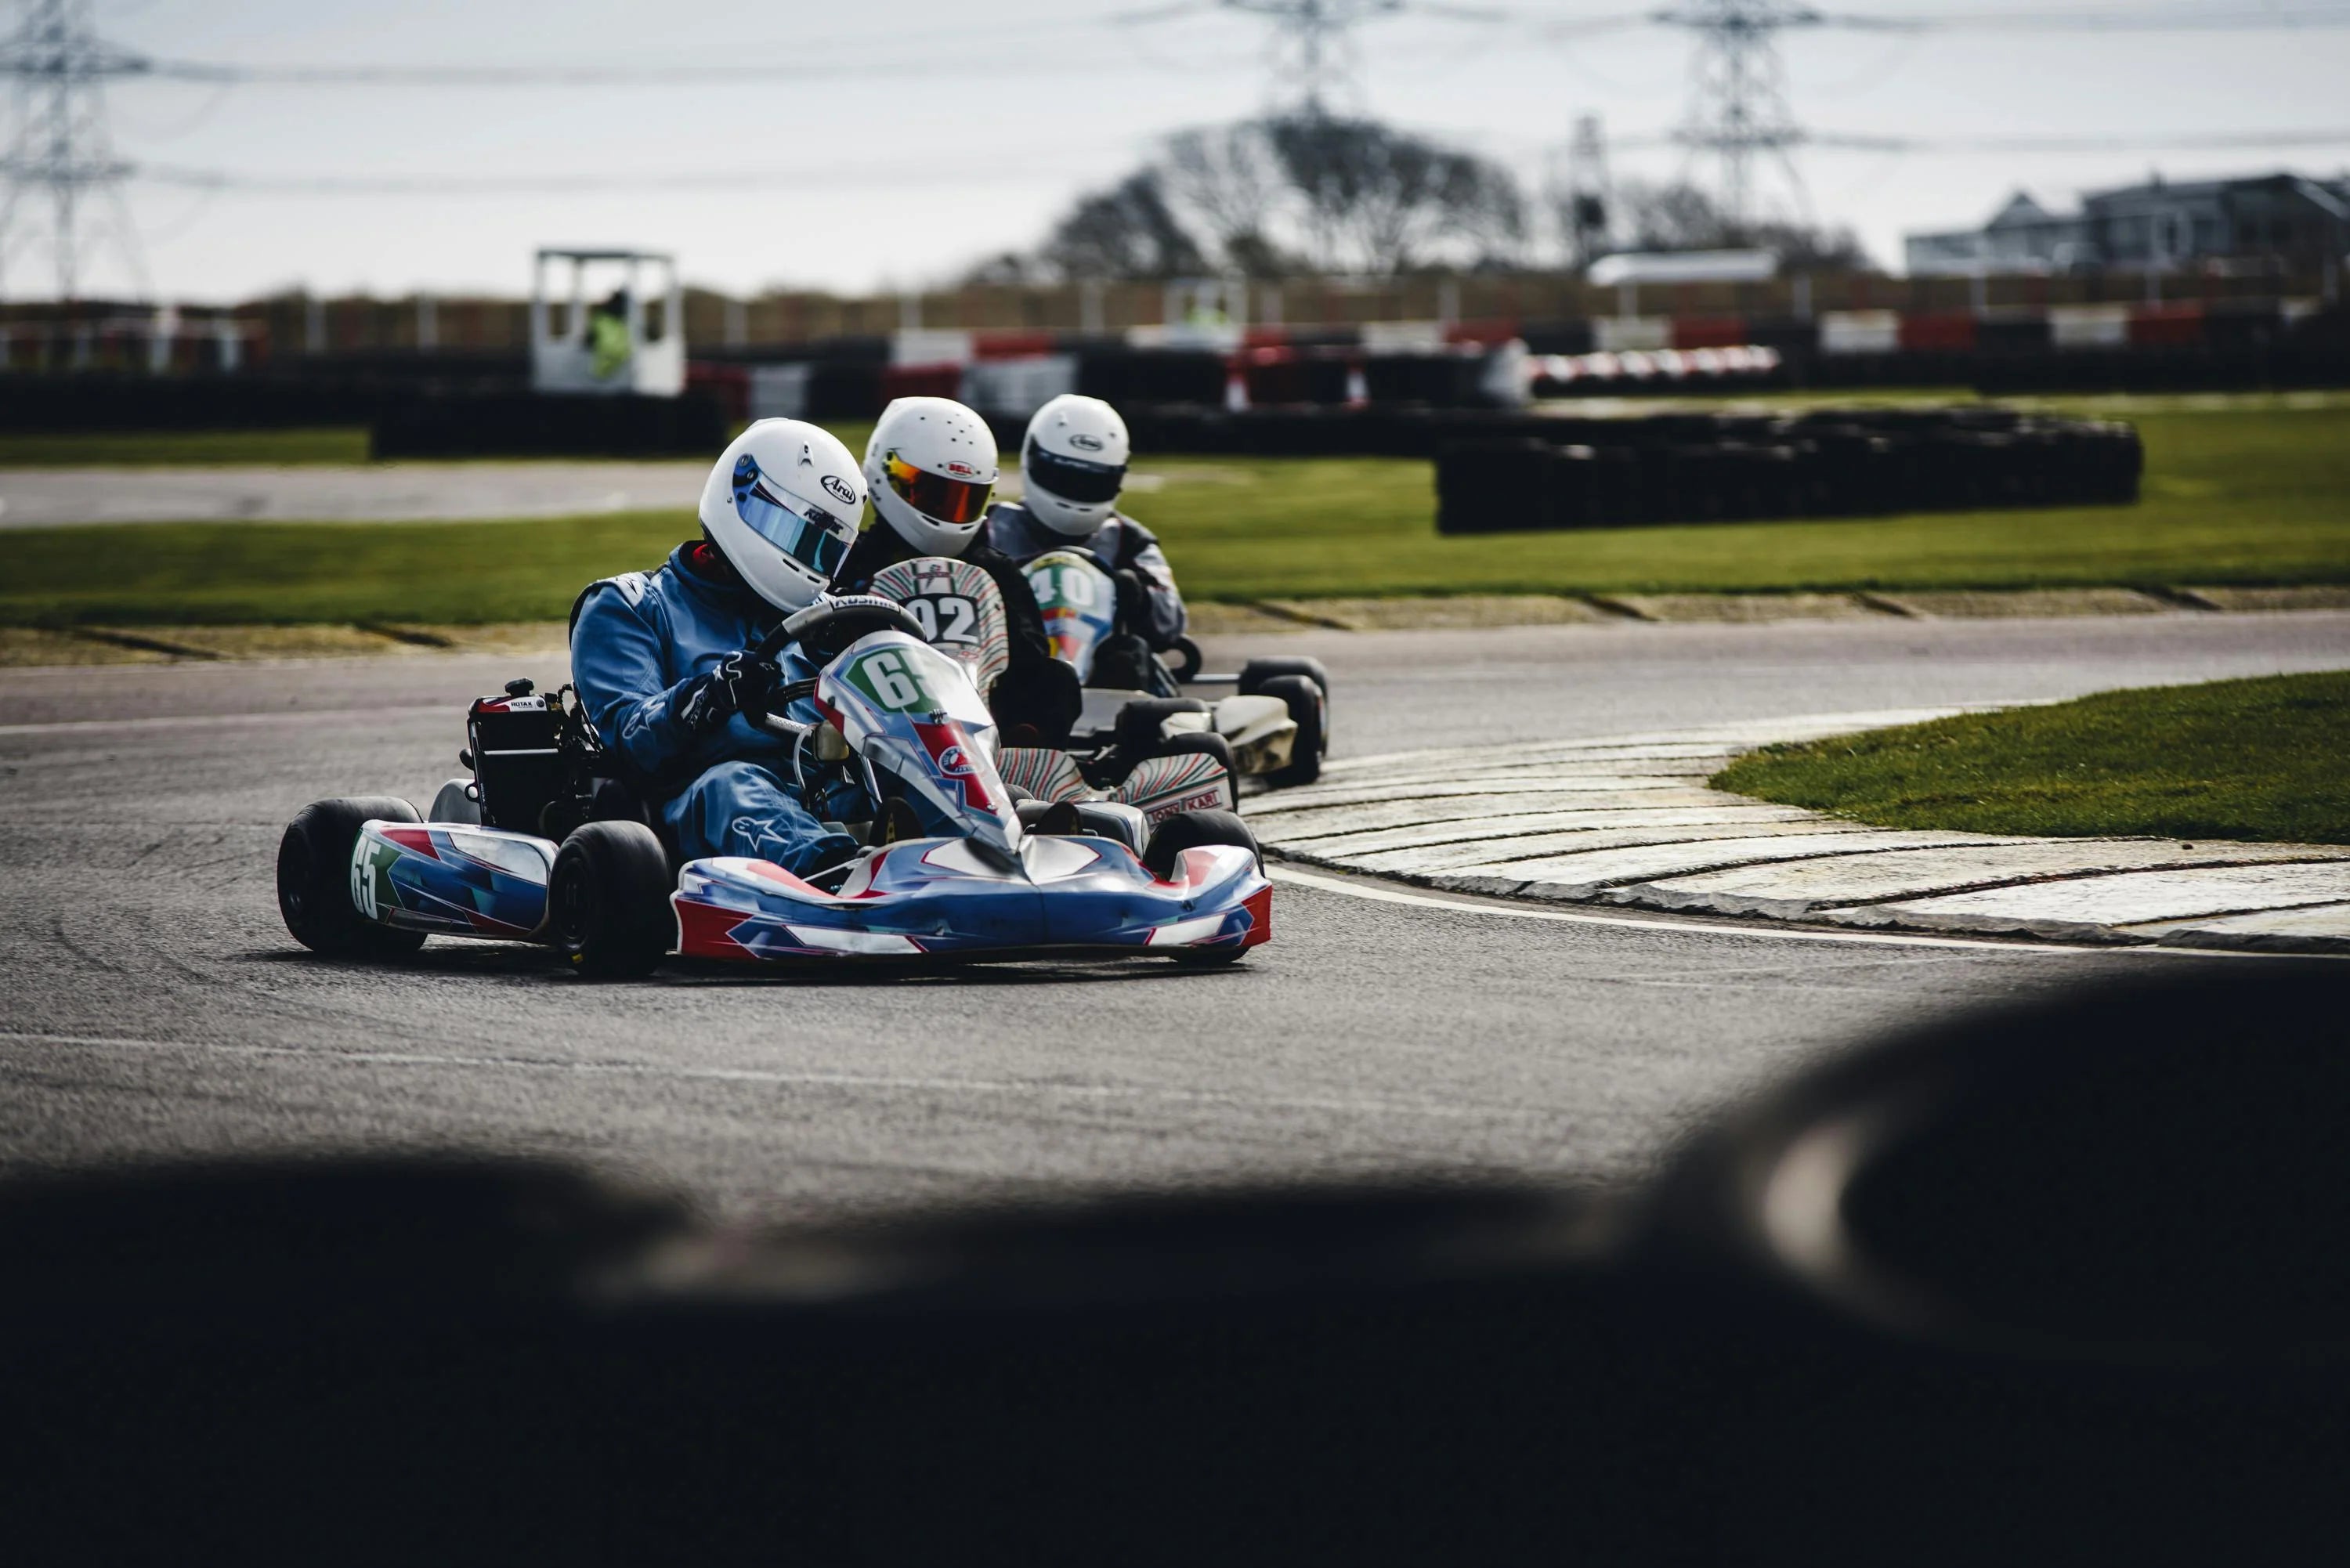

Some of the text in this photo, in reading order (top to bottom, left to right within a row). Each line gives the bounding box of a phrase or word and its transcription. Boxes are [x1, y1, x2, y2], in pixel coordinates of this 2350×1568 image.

[949, 463, 972, 475] BELL
[822, 478, 854, 500] Arai
[1029, 567, 1094, 606] 40
[906, 597, 979, 643] 92
[351, 835, 381, 920] 65
